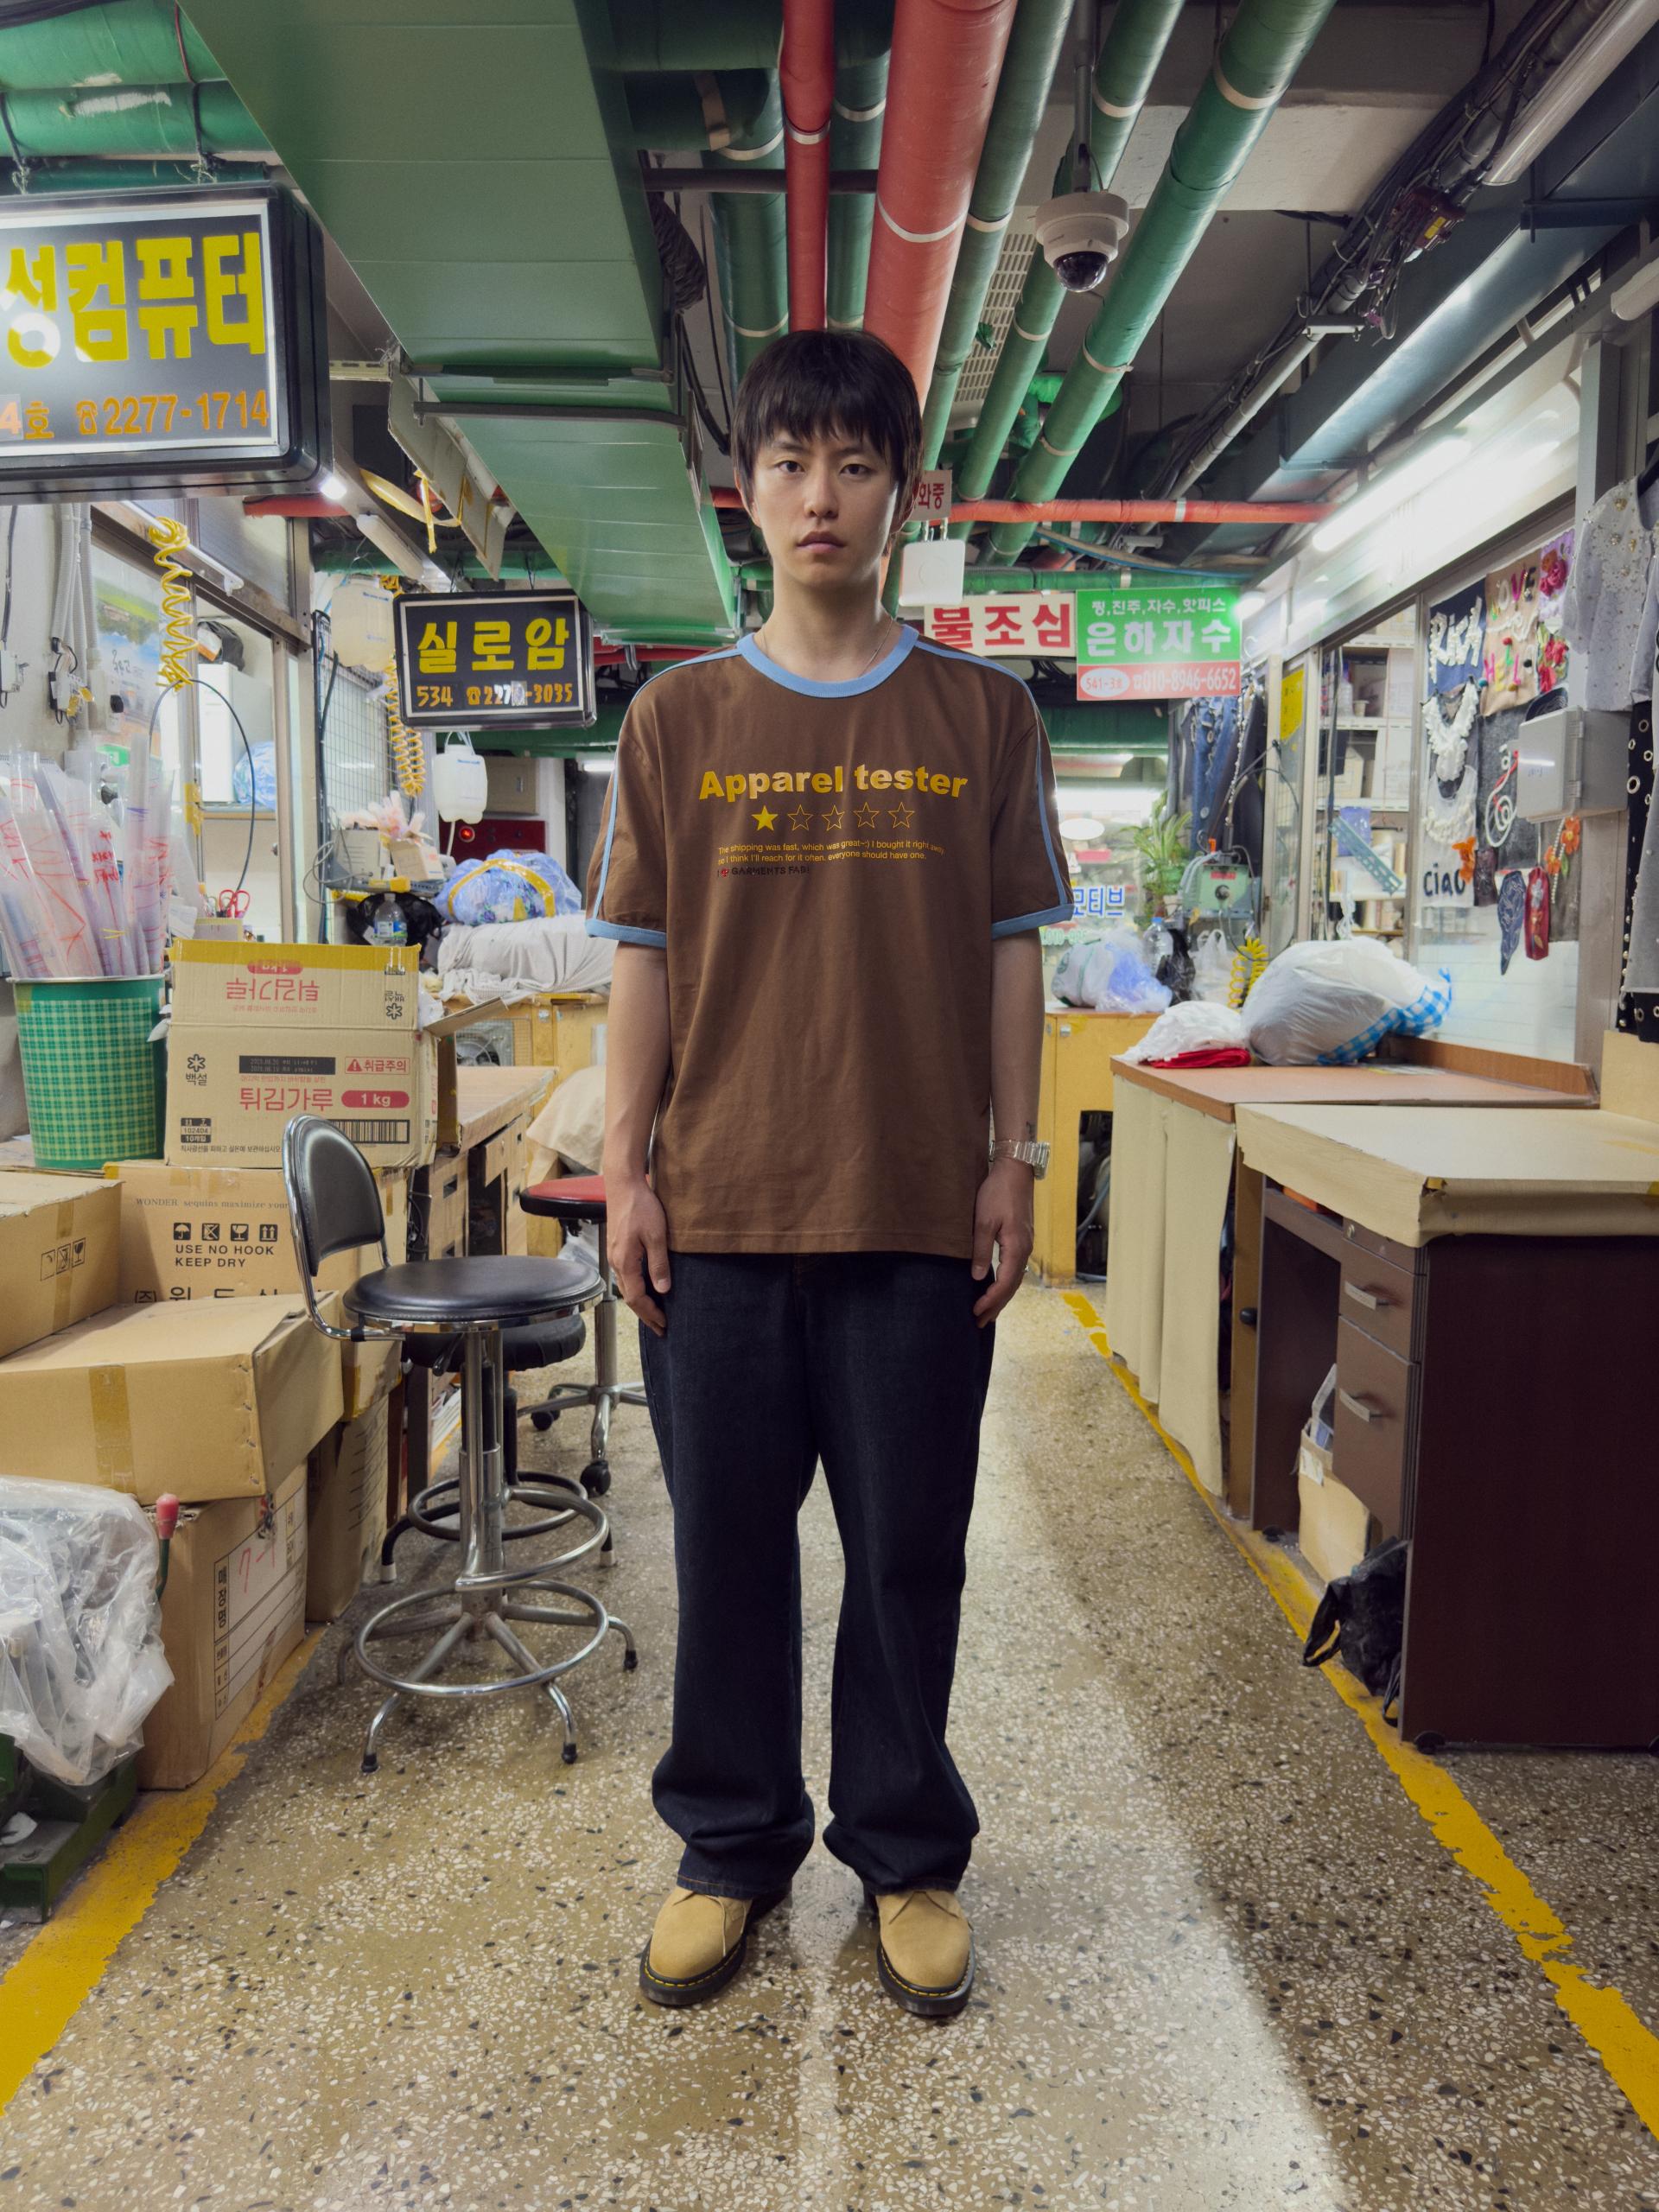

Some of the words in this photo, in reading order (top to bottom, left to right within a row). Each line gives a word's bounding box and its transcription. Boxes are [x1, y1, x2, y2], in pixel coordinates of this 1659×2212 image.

[0, 232, 265, 368] 성컴퓨터
[104, 390, 269, 435] 2277-1714
[912, 483, 944, 509] 화중
[931, 604, 1070, 648] 불조심
[417, 618, 569, 674] 실로암
[1087, 620, 1231, 658] 은하자수
[416, 686, 454, 707] 534
[699, 766, 843, 803] Apparel
[854, 764, 969, 798] tester
[719, 846, 728, 855] The
[730, 843, 763, 853] shipping
[876, 840, 904, 849] bought
[912, 840, 929, 849] right
[730, 854, 749, 862] think
[828, 851, 861, 860] everyone
[862, 850, 887, 859] should
[732, 867, 786, 875] GARMENTS
[226, 977, 320, 1001] 튀김가루
[363, 1059, 407, 1071] 취급주의
[186, 1072, 207, 1086] 백설
[239, 1087, 334, 1111] 튀김가루
[360, 1093, 367, 1105] 1
[372, 1092, 391, 1107] kg
[136, 1198, 178, 1206] WONDER
[184, 1199, 218, 1209] sequins
[221, 1200, 265, 1209] maximize
[175, 1244, 203, 1254] USE
[208, 1245, 229, 1255] NO
[234, 1246, 275, 1255] HOOK
[175, 1257, 212, 1267] KEEP
[217, 1258, 246, 1268] DRY
